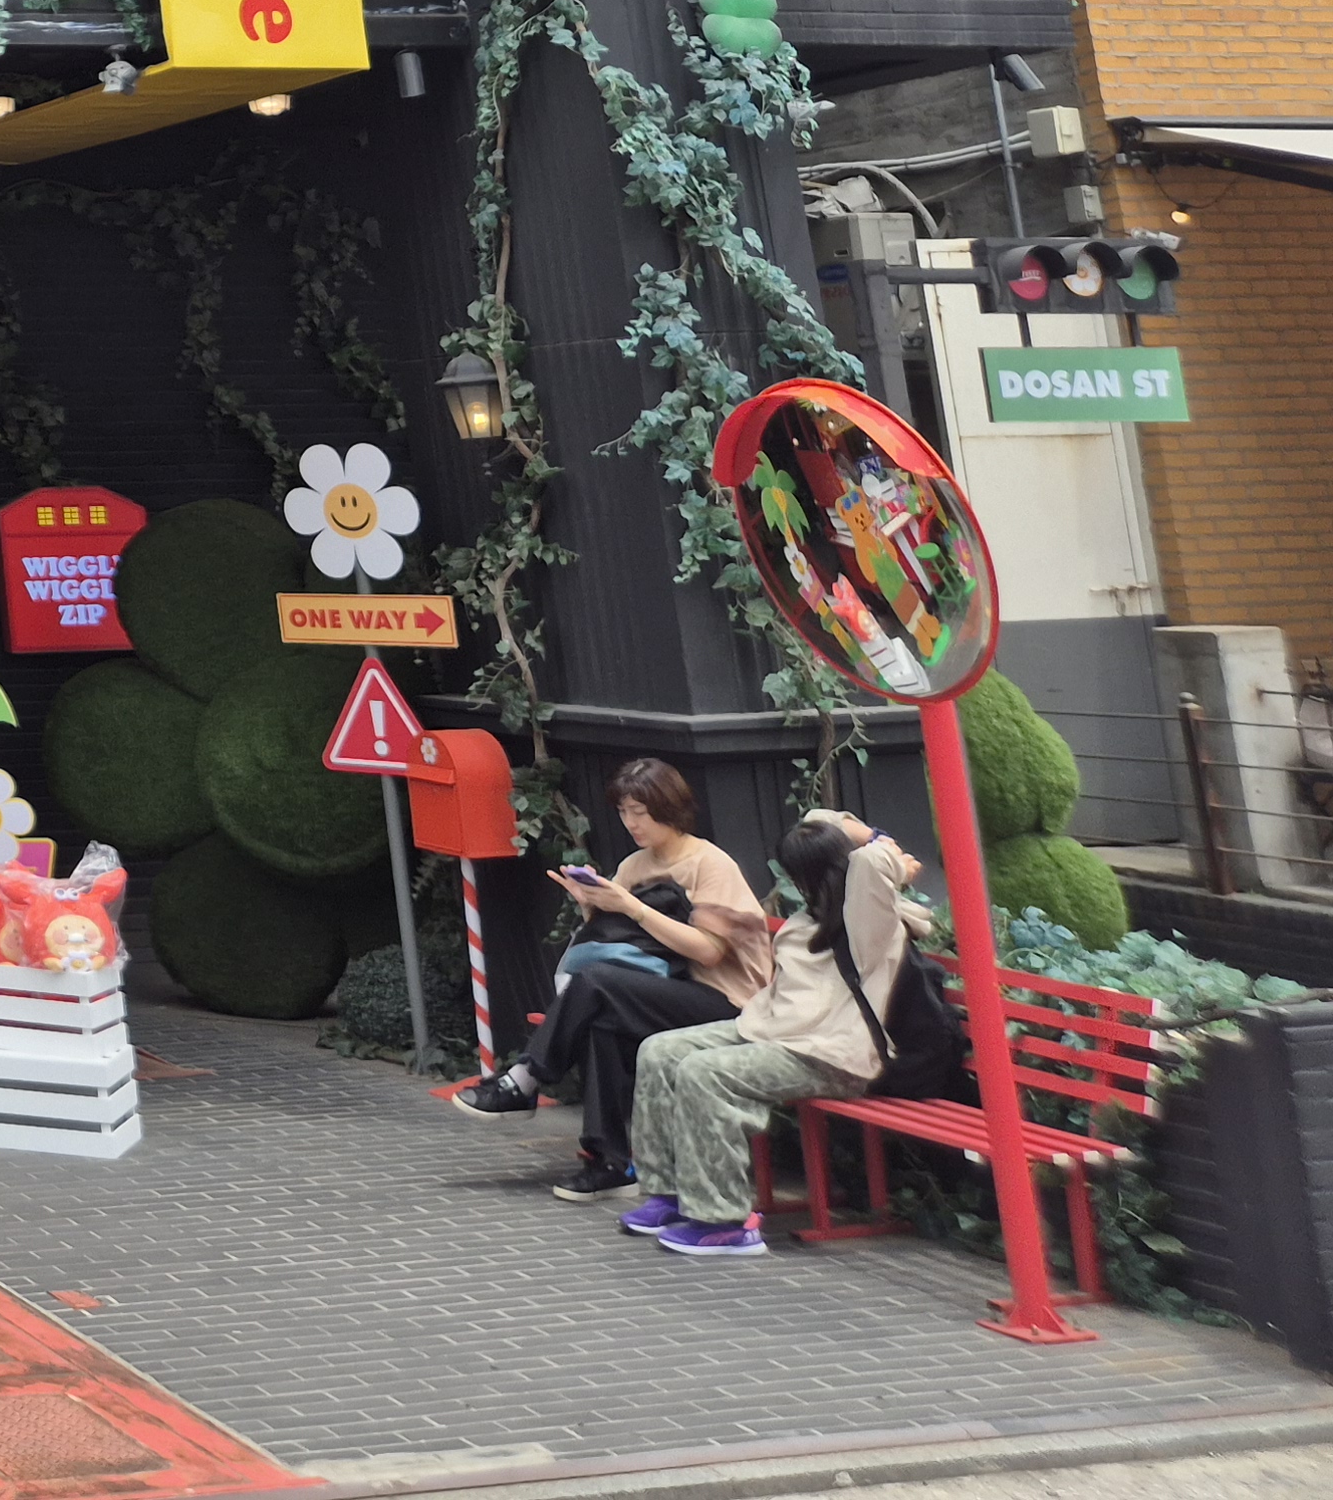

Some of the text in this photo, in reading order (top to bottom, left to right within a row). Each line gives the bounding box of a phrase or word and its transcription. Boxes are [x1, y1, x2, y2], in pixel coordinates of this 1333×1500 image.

[997, 368, 1171, 399] DOSAN ST
[23, 578, 117, 601] WIGGL
[57, 603, 107, 626] ZIP
[289, 608, 407, 630] ONE WAY
